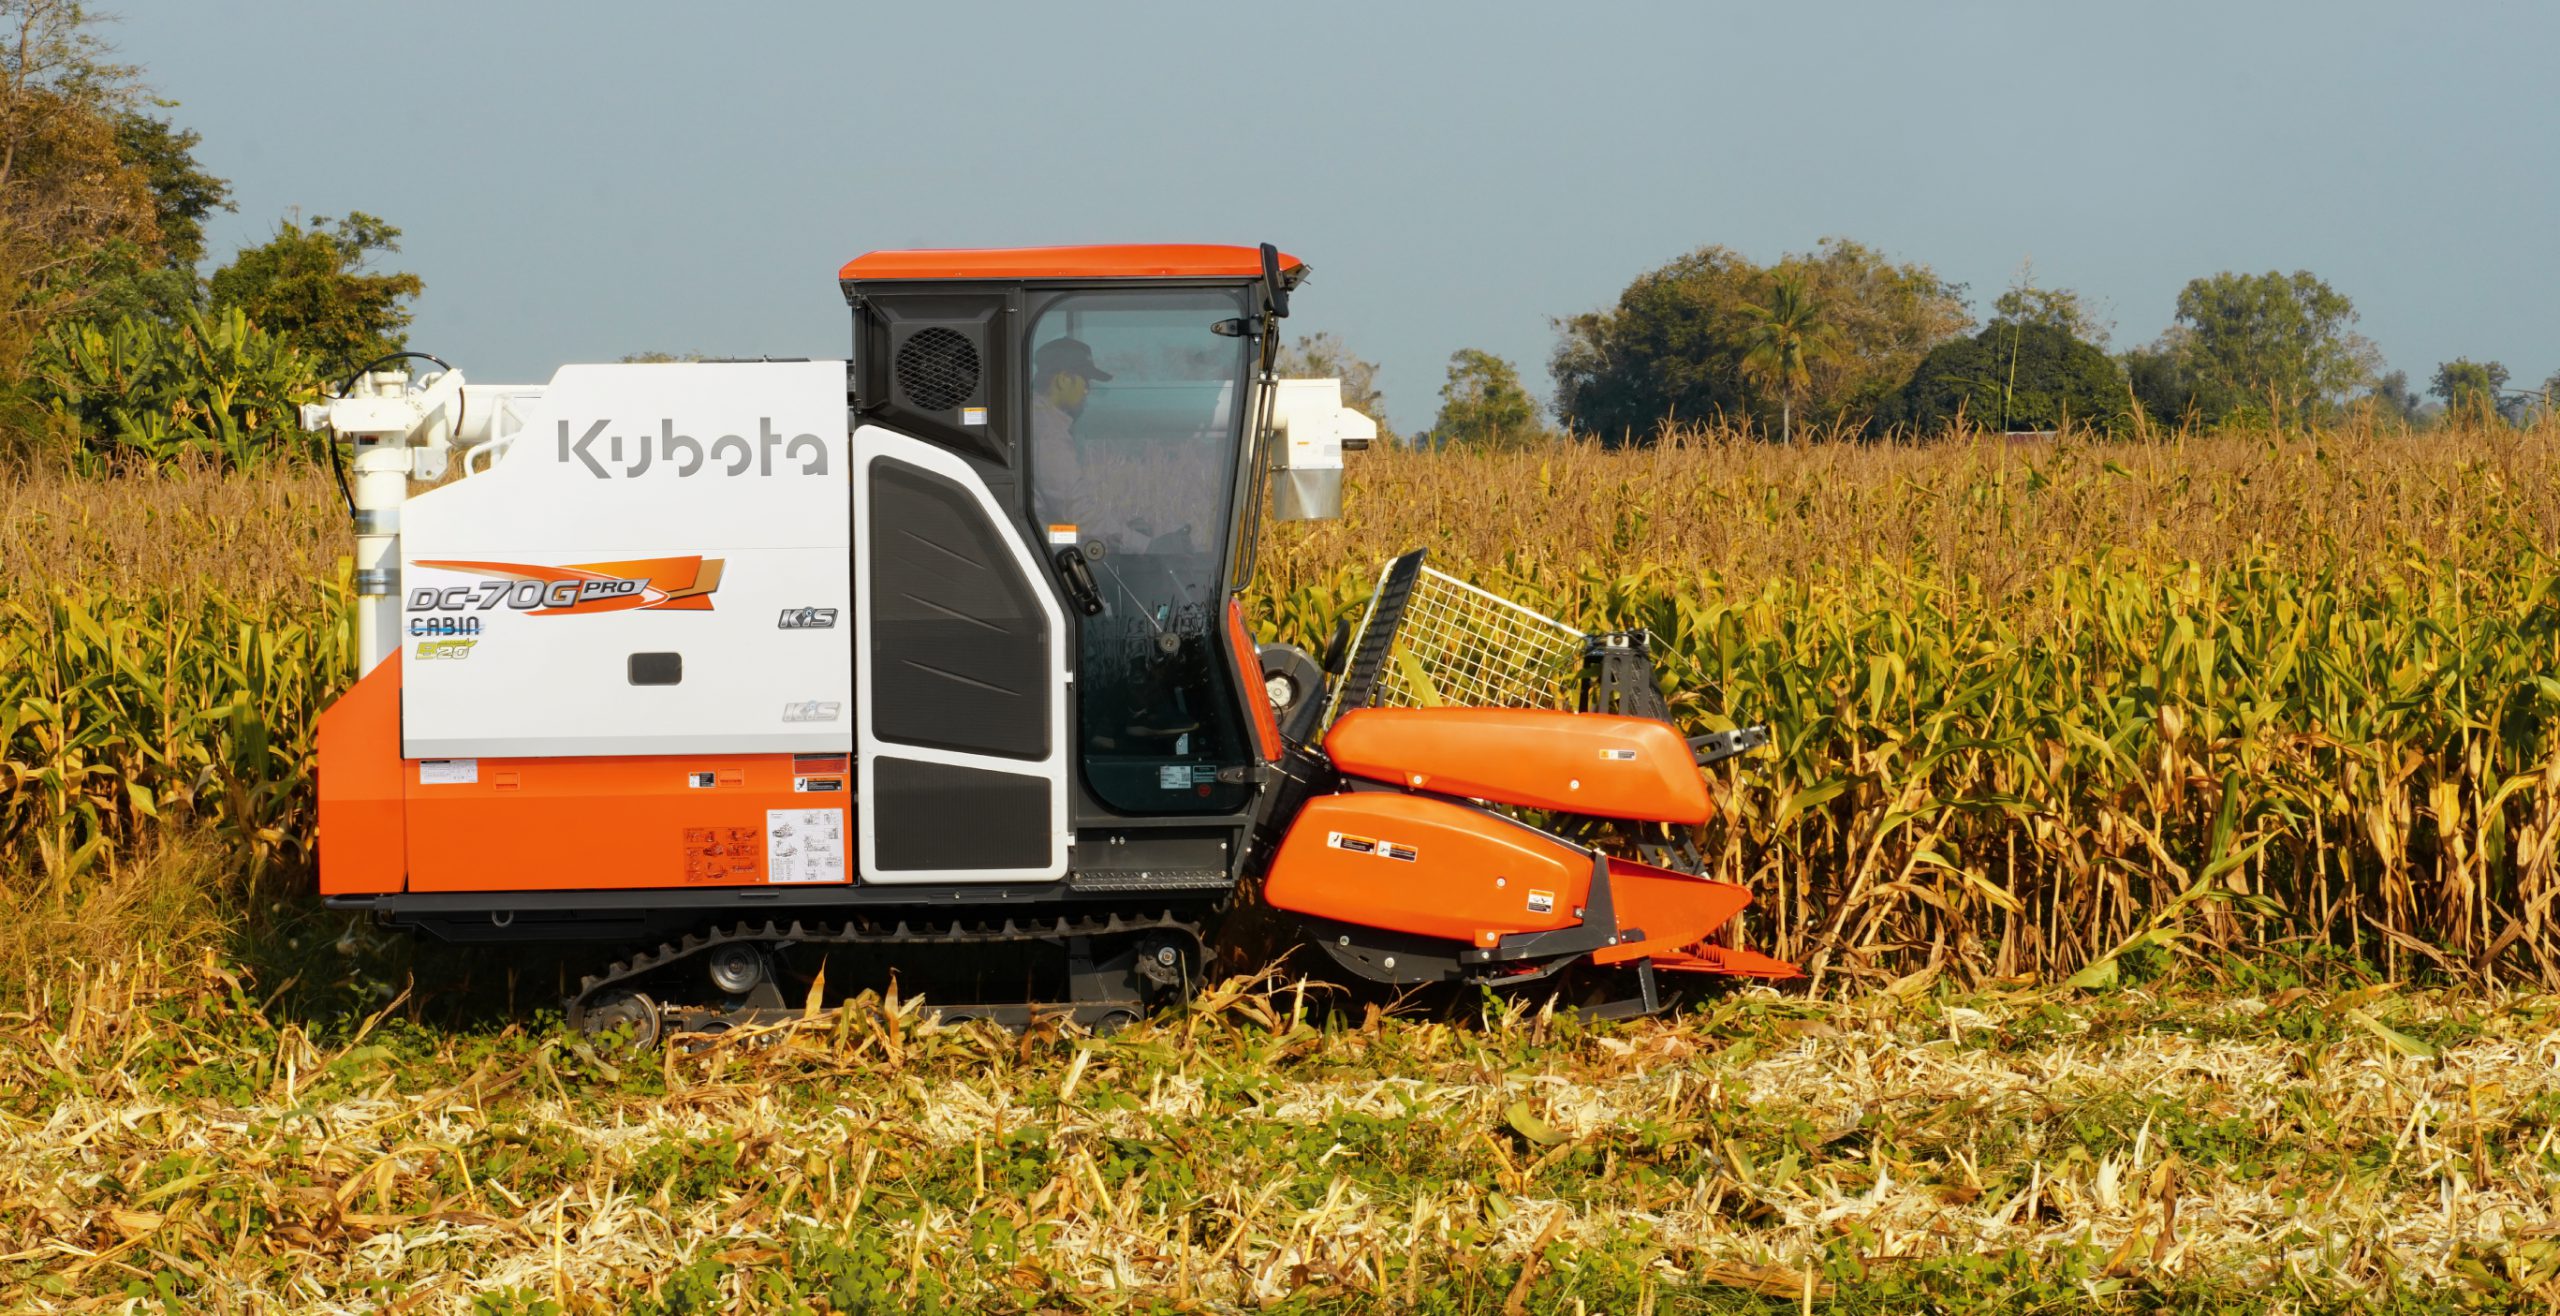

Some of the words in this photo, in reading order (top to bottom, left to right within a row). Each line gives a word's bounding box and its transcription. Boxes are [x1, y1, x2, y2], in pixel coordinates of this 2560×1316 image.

[558, 417, 828, 479] Kubota
[406, 579, 582, 611] DC-70G
[583, 580, 636, 594] PRO
[410, 616, 479, 636] CABIN
